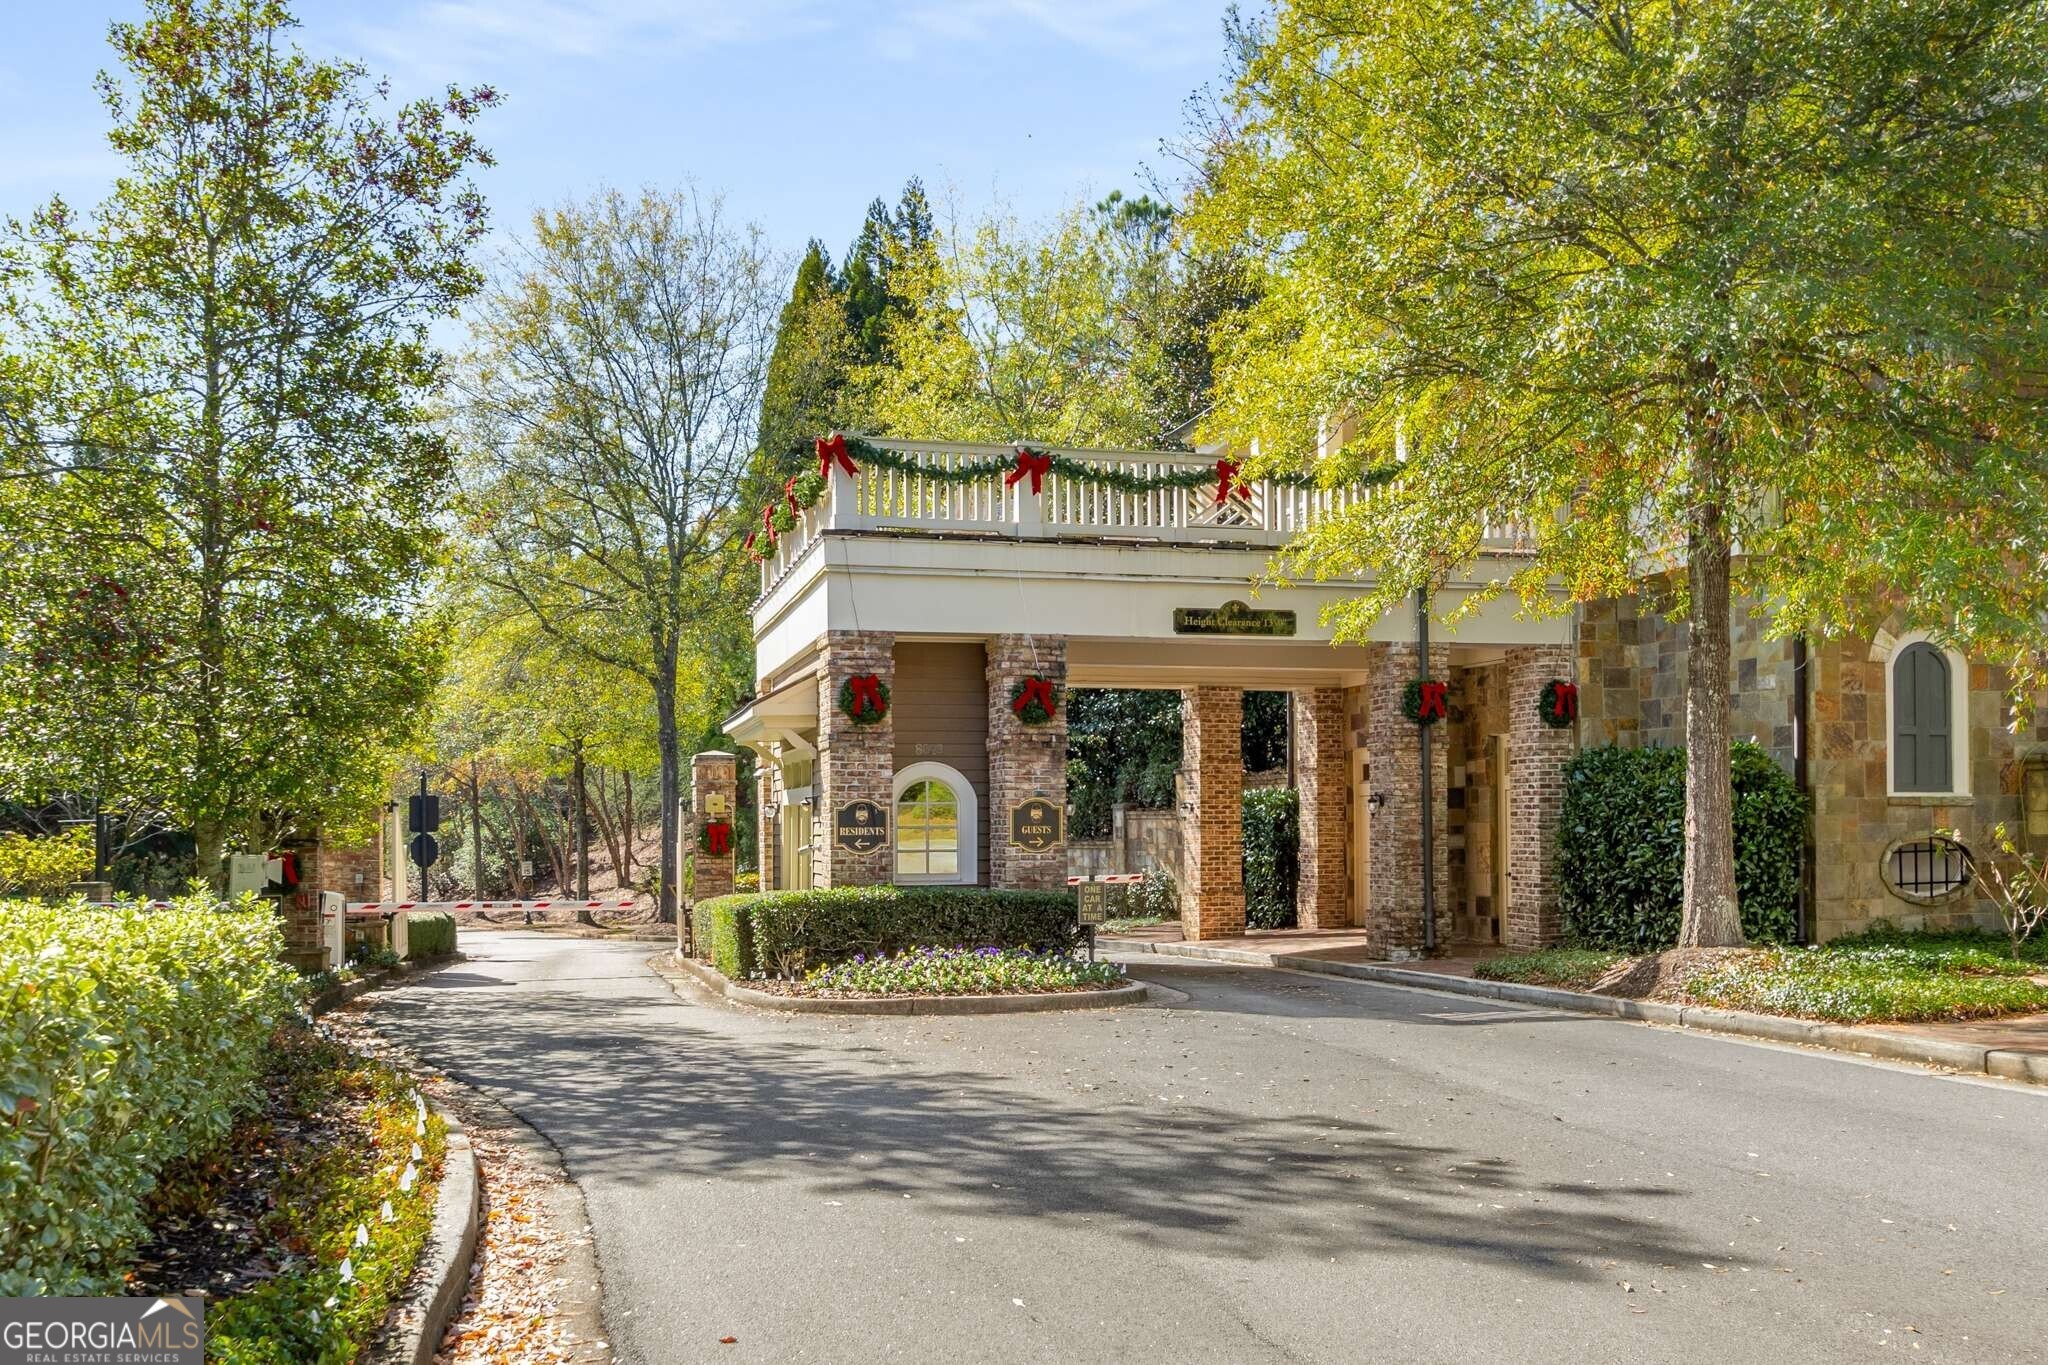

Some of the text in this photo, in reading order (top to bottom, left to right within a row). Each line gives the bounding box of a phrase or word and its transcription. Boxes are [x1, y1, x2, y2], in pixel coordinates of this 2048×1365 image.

[1184, 616, 1215, 628] Height
[1217, 616, 1260, 627] Clearance
[839, 826, 885, 836] RESIDENTS
[1021, 825, 1052, 834] GUESTS
[1084, 885, 1102, 893] ONE
[1084, 895, 1101, 903] CAR
[1082, 904, 1103, 912] AT A
[1082, 912, 1104, 921] TIME
